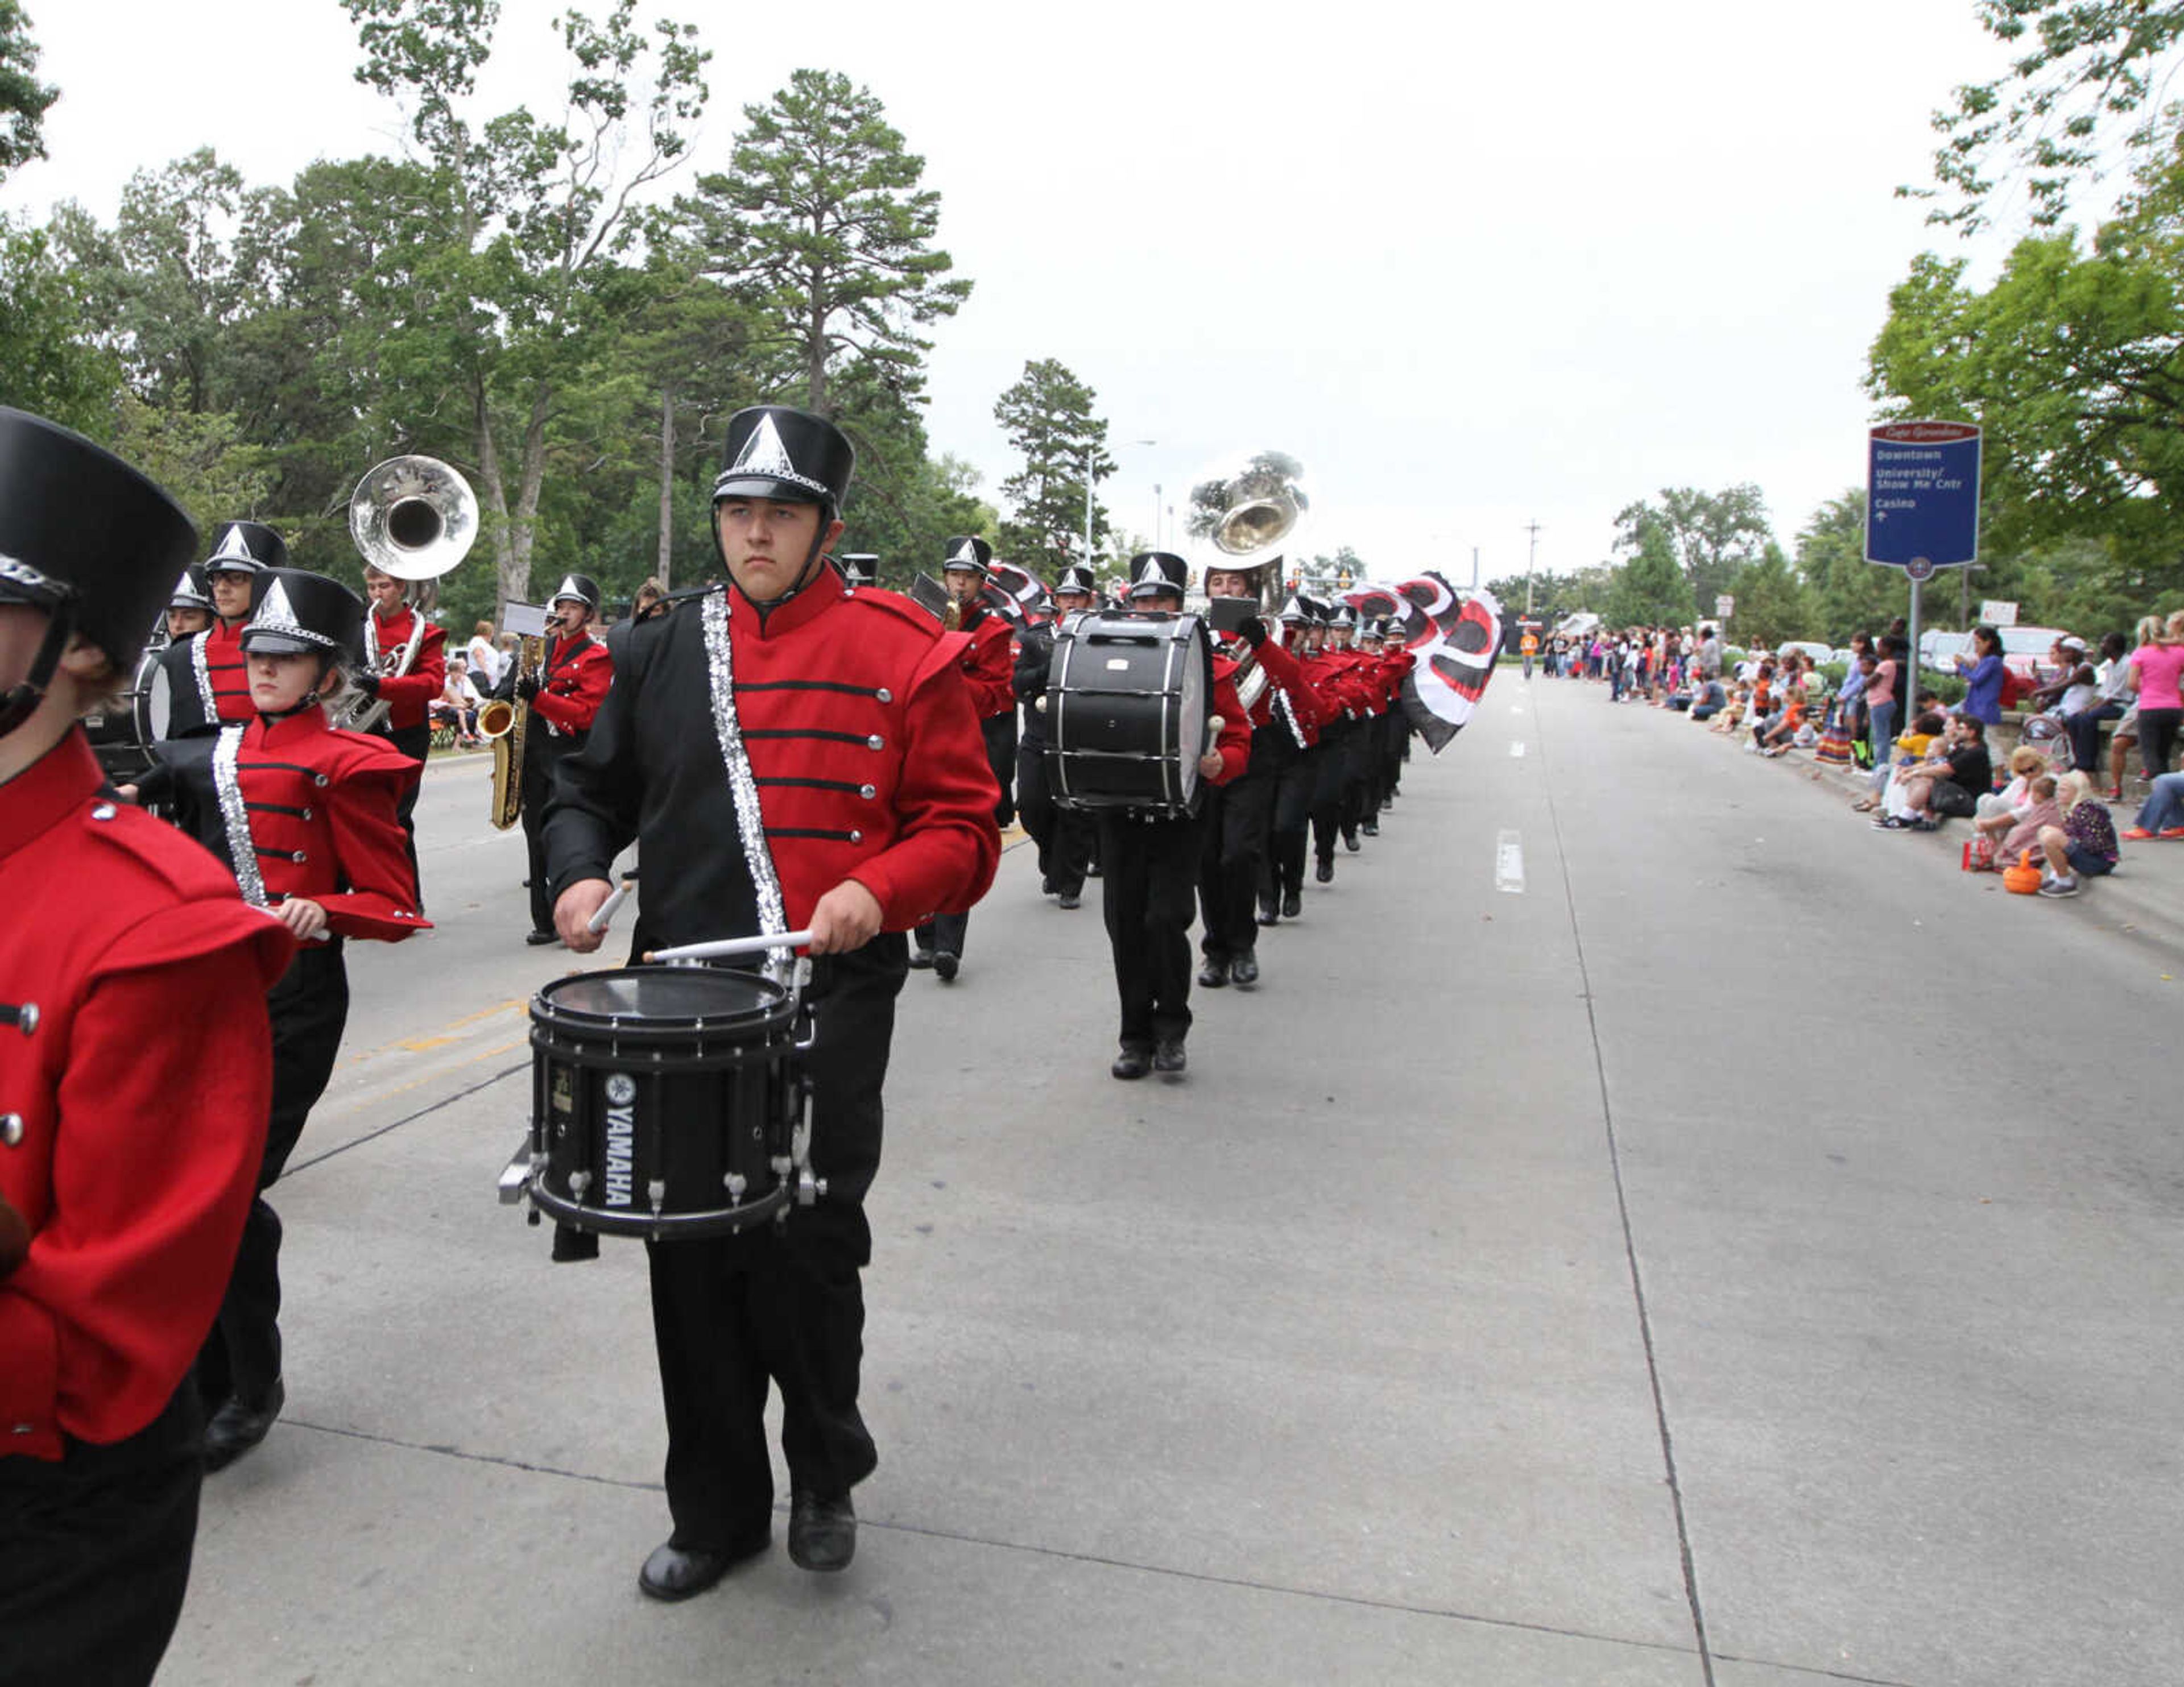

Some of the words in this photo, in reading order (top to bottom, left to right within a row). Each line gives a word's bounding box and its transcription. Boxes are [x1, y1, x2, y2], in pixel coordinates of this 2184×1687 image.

[1877, 450, 1942, 461] Downtown
[1877, 467, 1945, 479] University/
[1877, 479, 1908, 489] Show
[1876, 498, 1916, 508] Casino
[606, 1106, 633, 1205] YAMAHA
